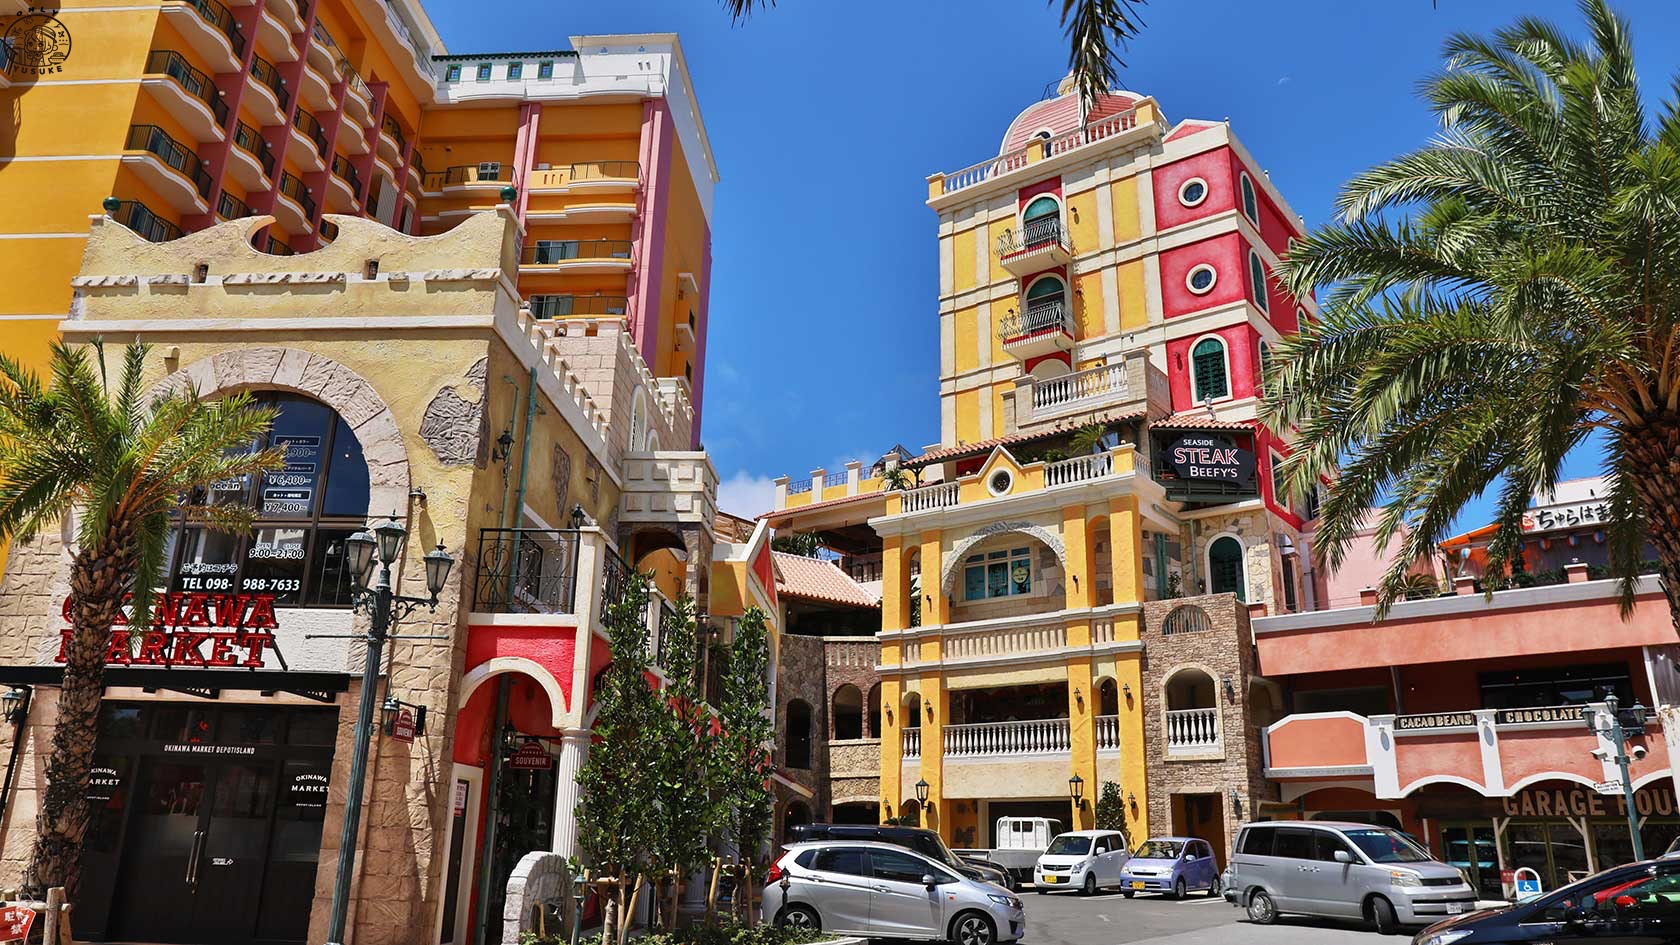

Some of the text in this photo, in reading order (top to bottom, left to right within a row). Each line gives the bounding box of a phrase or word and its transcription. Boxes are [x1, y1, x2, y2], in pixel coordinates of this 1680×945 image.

[1174, 447, 1240, 465] STEAK
[1189, 465, 1238, 478] BEEFY'S
[209, 482, 241, 491] ocean
[183, 578, 301, 591] TEL 098- 988-7633
[1400, 714, 1472, 729] CACAO BEANS
[1505, 708, 1584, 723] CHOCOLATE
[164, 744, 256, 755] OKINAWA MARKET DEPOTISLAND
[515, 756, 547, 766] SOUVENIR
[90, 767, 117, 776] KINAWA
[89, 778, 120, 786] ARKET
[295, 774, 327, 783] OKINAWA
[1503, 788, 1606, 817] GARAGE
